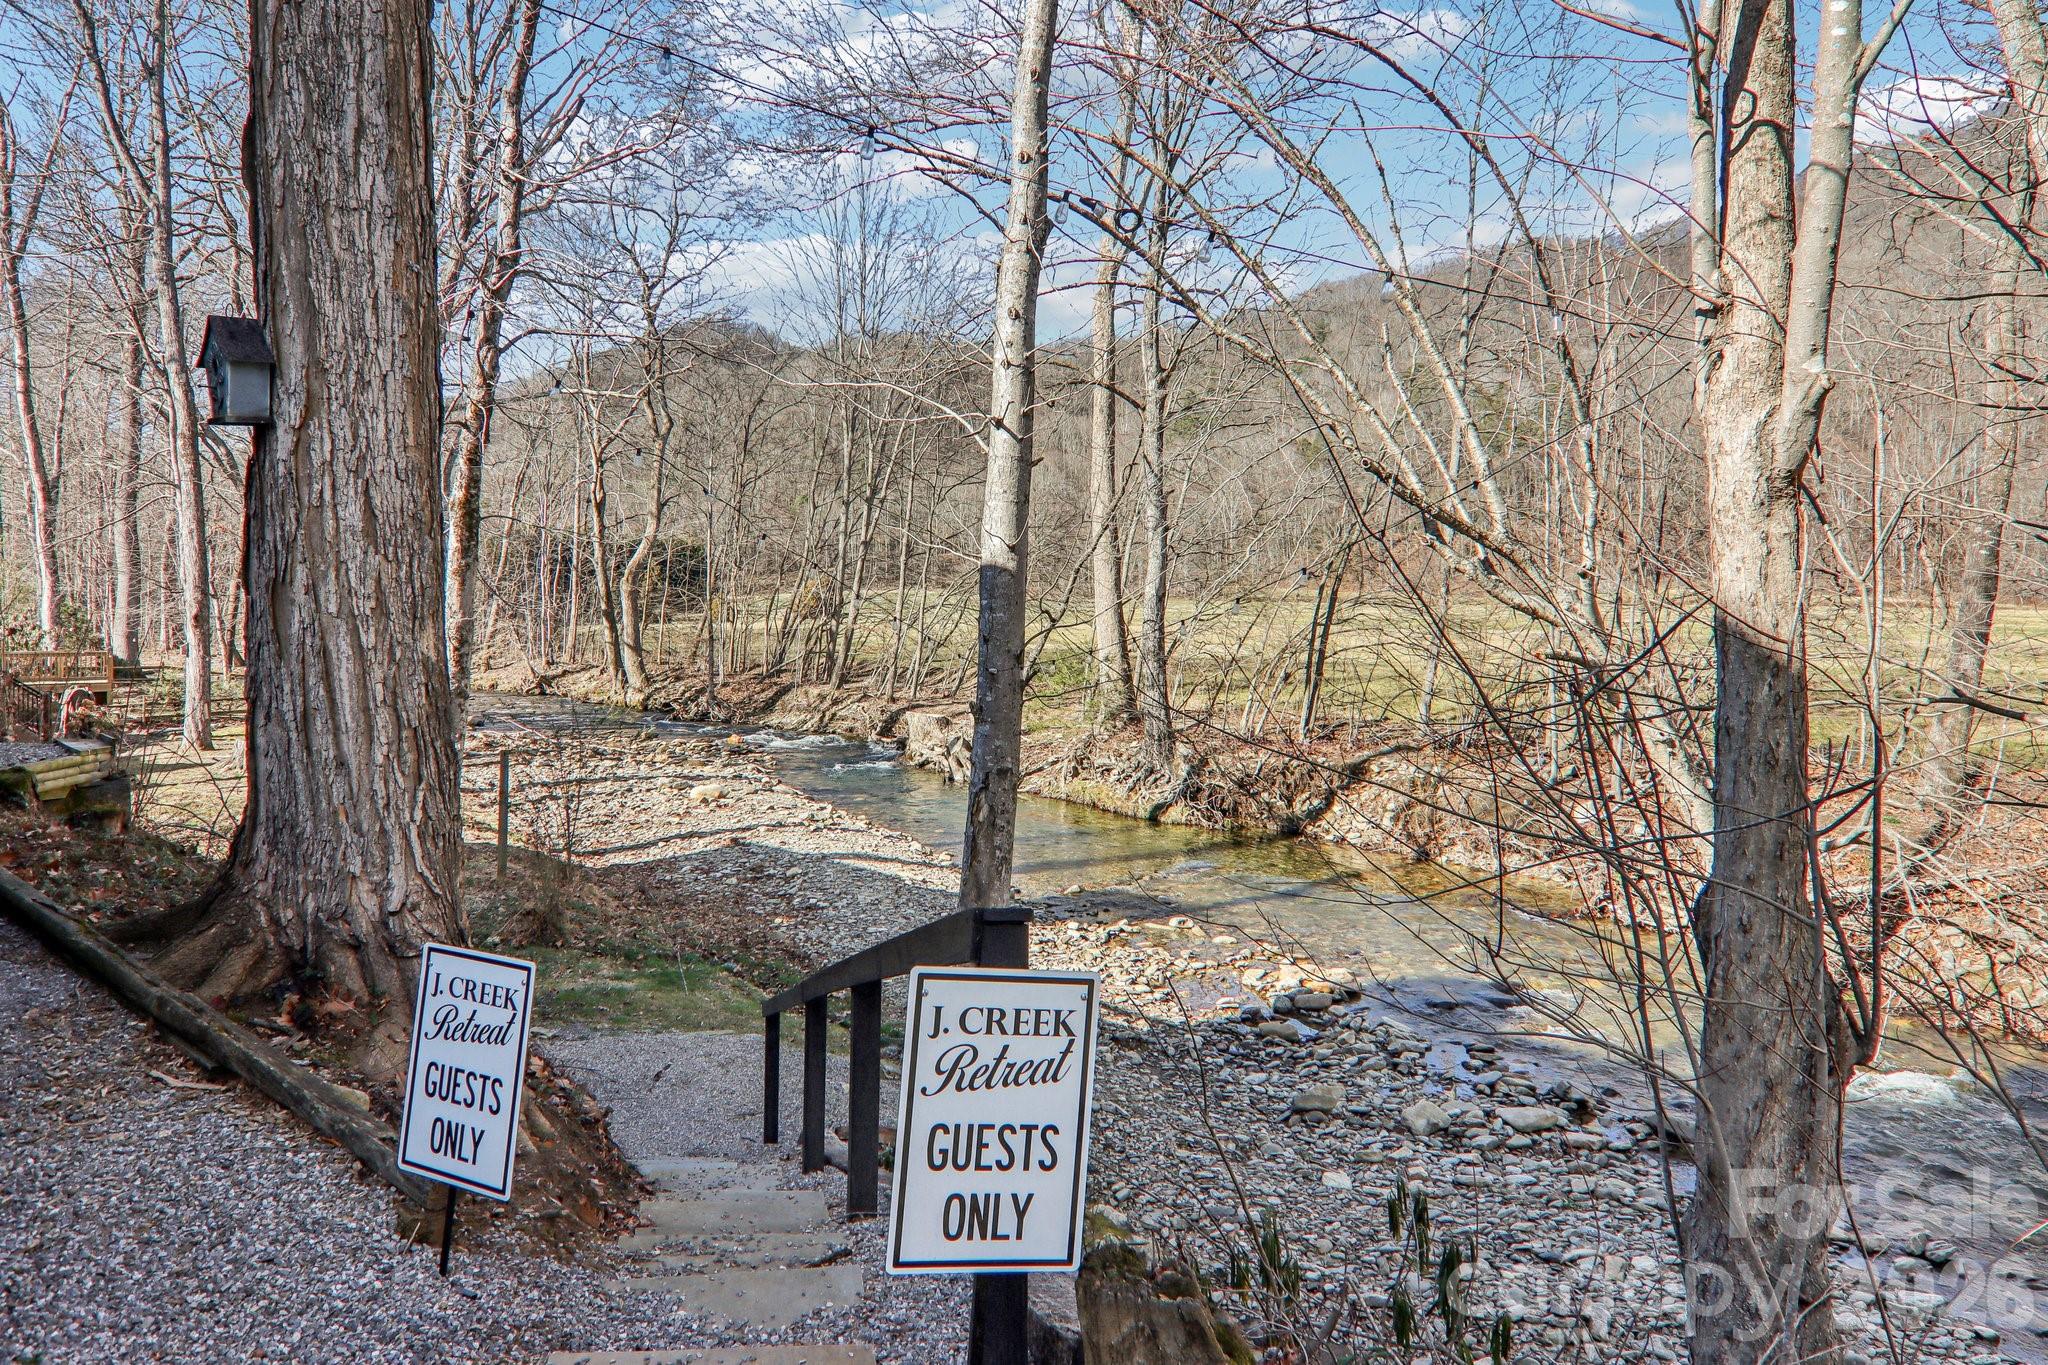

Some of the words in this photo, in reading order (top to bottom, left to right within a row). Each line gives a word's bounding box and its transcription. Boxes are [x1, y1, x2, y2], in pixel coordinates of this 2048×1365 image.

[430, 972, 444, 998] J.
[449, 975, 520, 1012] CREEK
[424, 1003, 517, 1047] Retreat
[927, 1005, 950, 1039] J.
[958, 1006, 1078, 1038] CREEK
[424, 1061, 504, 1116] GUESTS
[920, 1037, 1076, 1097] Retreat
[430, 1116, 486, 1166] ONLY
[926, 1123, 1060, 1172] GUESTS
[942, 1192, 1035, 1241] ONLY
